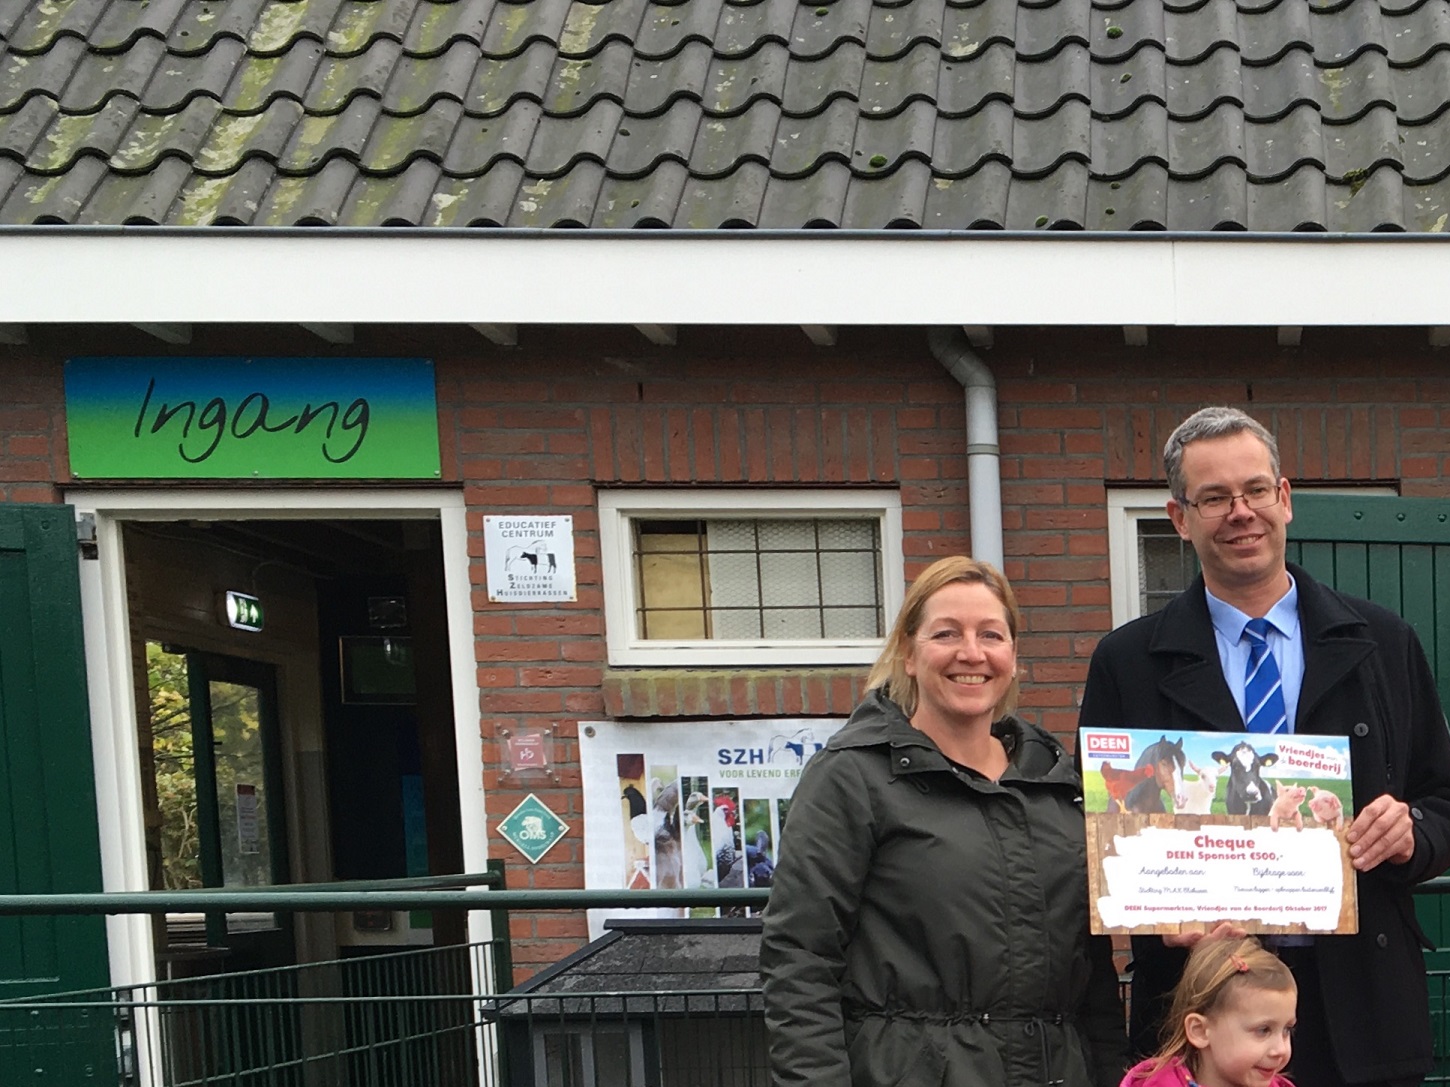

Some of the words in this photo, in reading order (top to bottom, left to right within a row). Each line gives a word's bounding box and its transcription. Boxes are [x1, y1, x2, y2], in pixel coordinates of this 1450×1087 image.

[135, 376, 370, 463] Ingang
[498, 521, 556, 529] EDUCATIEF
[501, 530, 554, 538] CENTRUM
[1090, 737, 1127, 750] DEEN
[718, 748, 764, 765] SZH
[1279, 745, 1325, 759] Vriendjes
[1288, 756, 1341, 775] boerderij
[719, 769, 744, 778] VOOR
[746, 769, 781, 778] LEVEND
[519, 829, 547, 840] OMS
[1194, 835, 1255, 850] Cheque
[1166, 851, 1194, 860] DEEN
[1198, 851, 1246, 862] Sponsort
